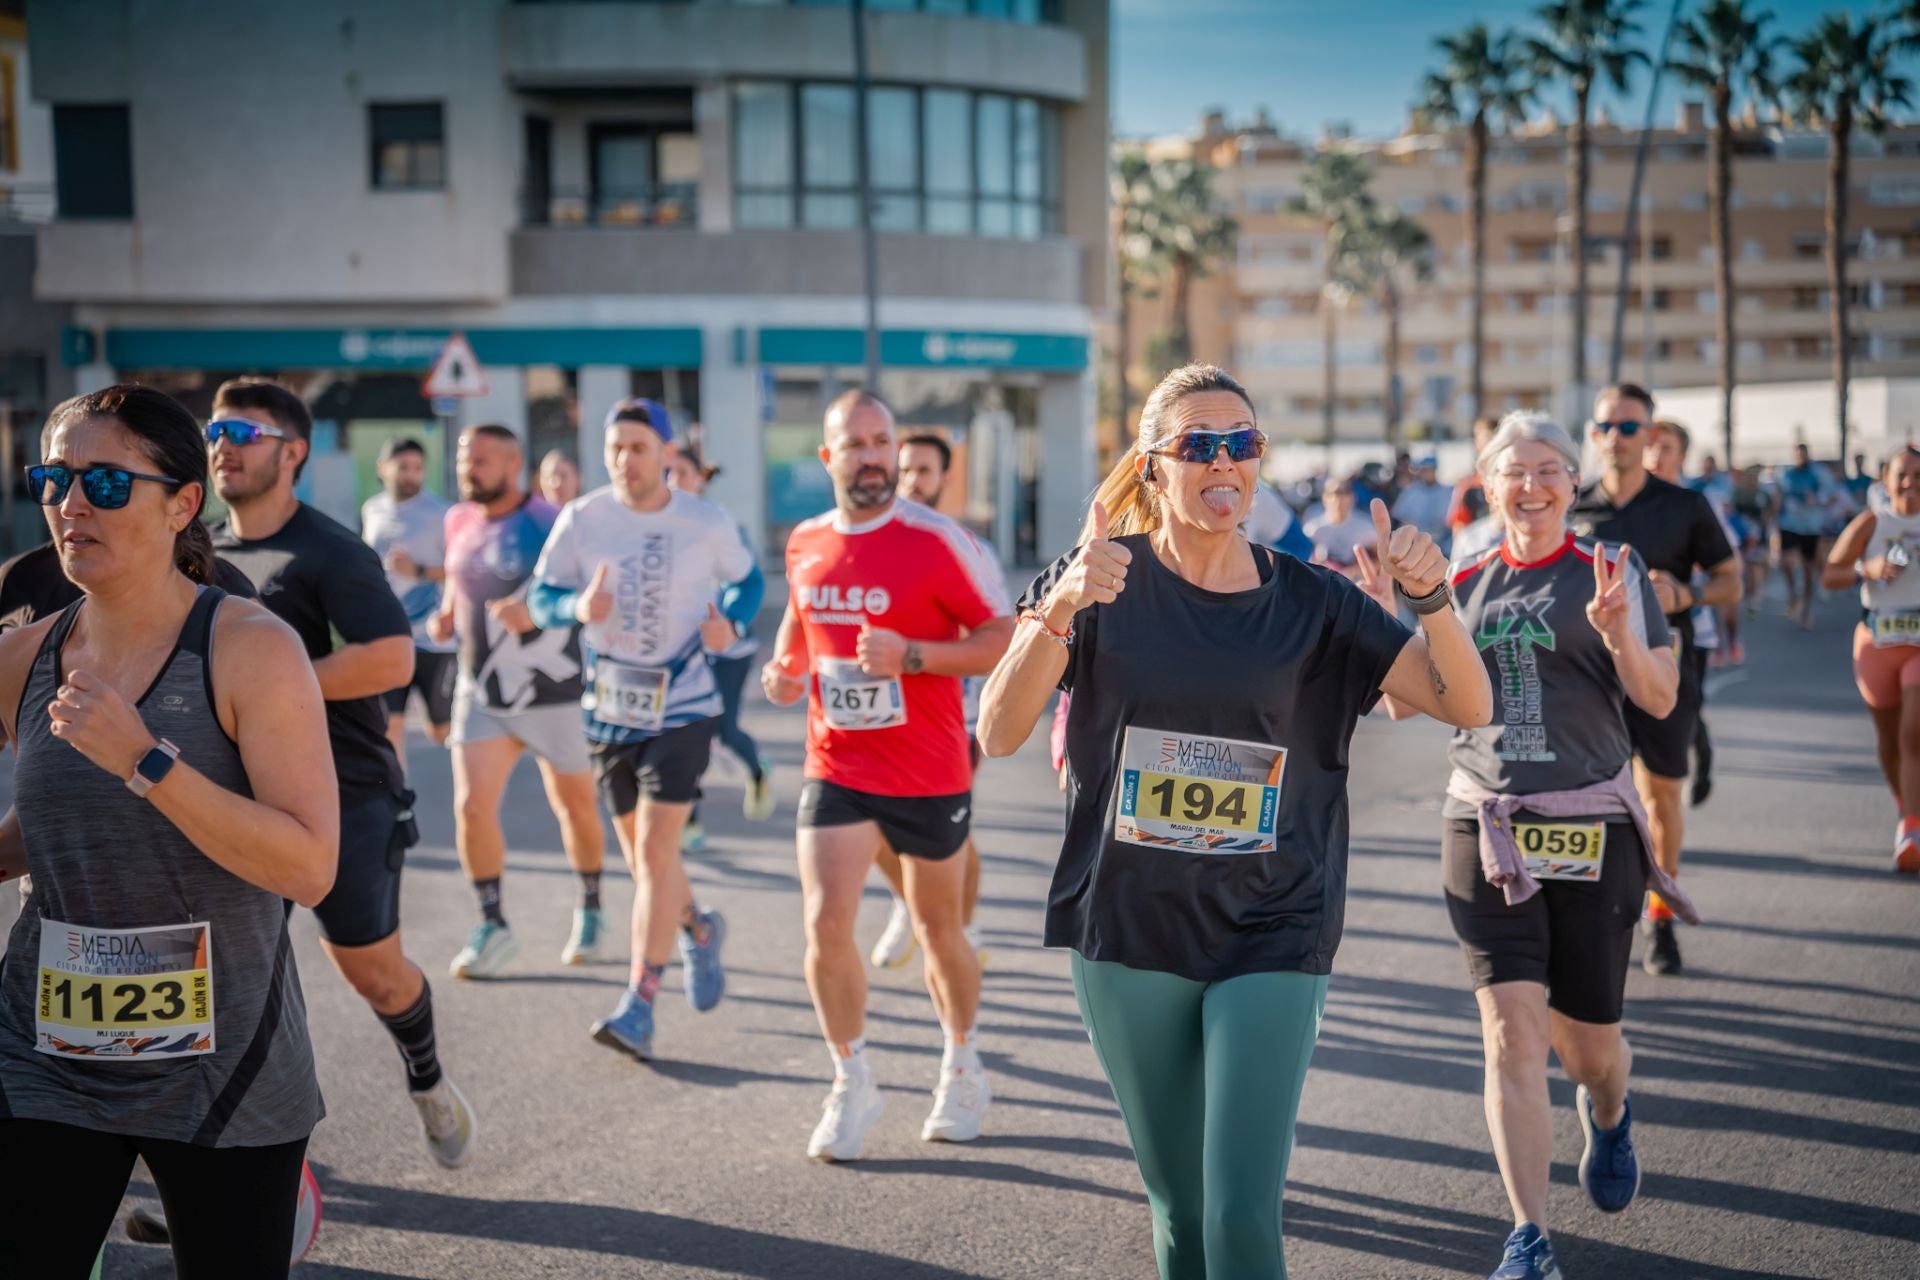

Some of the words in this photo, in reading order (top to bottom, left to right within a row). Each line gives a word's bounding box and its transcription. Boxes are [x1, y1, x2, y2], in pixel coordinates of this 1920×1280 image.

[618, 556, 638, 631] MEDIA
[1479, 597, 1555, 646] IX
[1495, 636, 1524, 724] CARRERA
[1521, 650, 1542, 723] NOCTURNA
[830, 687, 879, 710] 267
[1502, 727, 1545, 743] CONTRA
[1160, 737, 1177, 764] VIII
[1177, 739, 1232, 761] MEDIA
[1145, 764, 1184, 774] CIUDAD
[1179, 757, 1241, 773] MARATON
[1151, 778, 1247, 826] 194
[1195, 826, 1207, 834] DEL
[67, 931, 81, 961] VIII
[81, 933, 145, 955] MEDIA
[56, 961, 91, 974] CIUDAD
[85, 953, 160, 968] MARATON
[55, 979, 186, 1023] 1123
[192, 990, 206, 1018] CAJÓN
